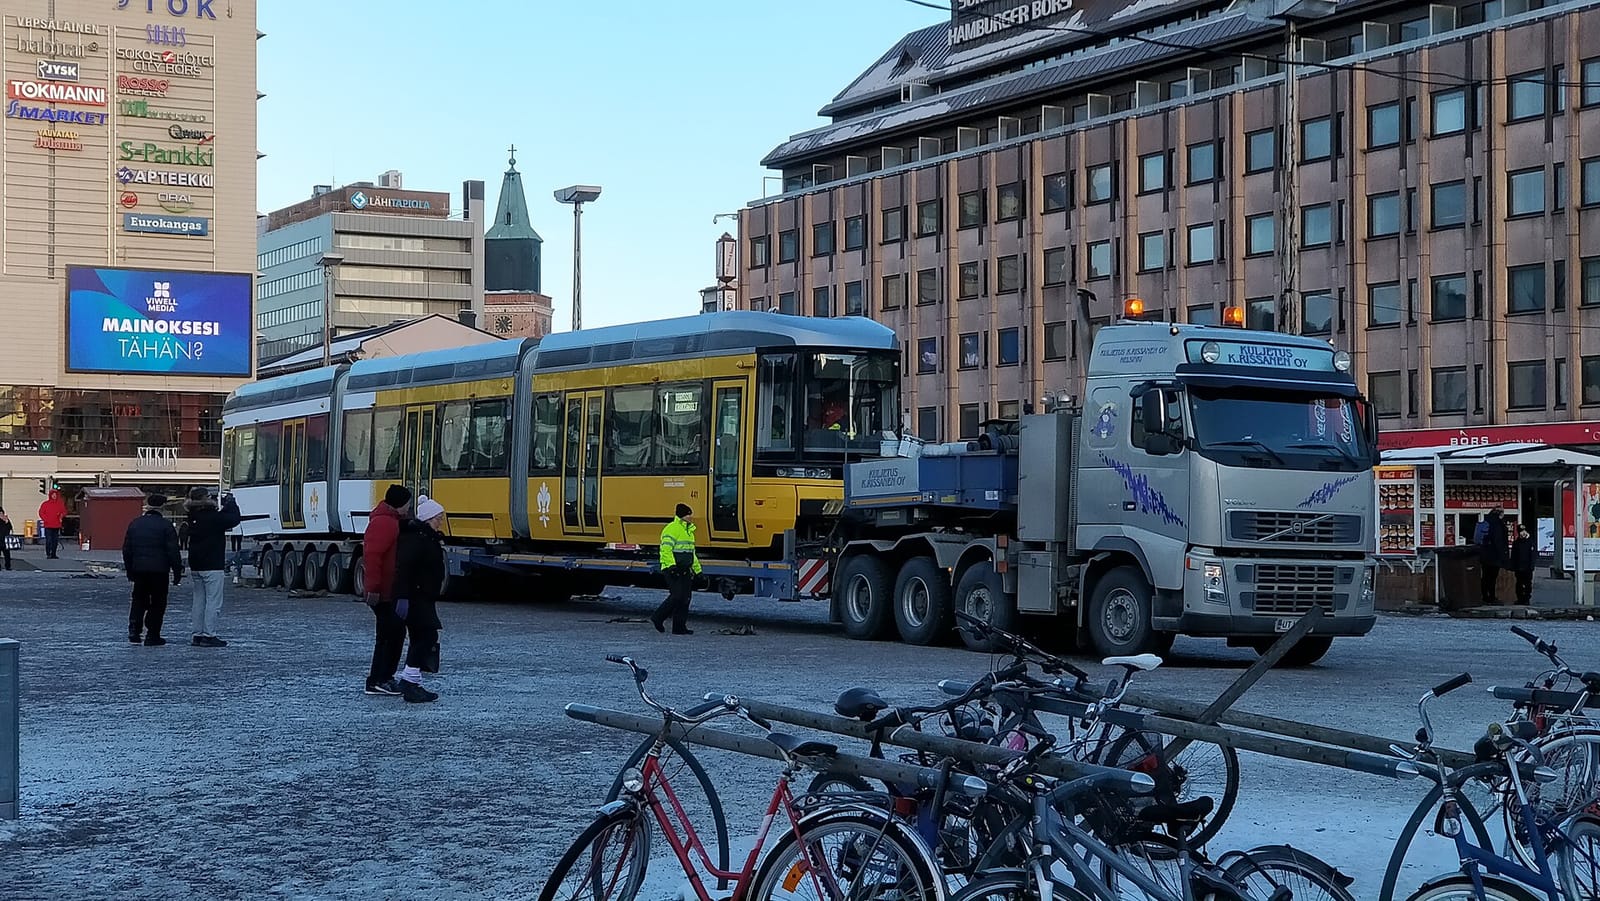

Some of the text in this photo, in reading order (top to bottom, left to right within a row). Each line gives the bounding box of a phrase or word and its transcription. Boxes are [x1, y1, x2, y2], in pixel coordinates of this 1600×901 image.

[116, 47, 215, 66] SOKOS HOTEL
[46, 64, 77, 76] JYSK
[133, 60, 164, 73] CITY
[11, 81, 105, 103] TOKMANNI
[120, 141, 213, 167] S-Pankki
[134, 171, 213, 187] APTEEKKI
[369, 195, 431, 209] LÄHITAPIOLA
[130, 217, 202, 231] Eurokangas
[145, 297, 179, 306] VIWELL
[148, 304, 176, 313] MEDIA
[102, 317, 220, 336] MAINOKSESI
[118, 335, 204, 360] TÄHÄN?
[1240, 345, 1293, 358] KULJETUS
[1294, 358, 1308, 368] OY
